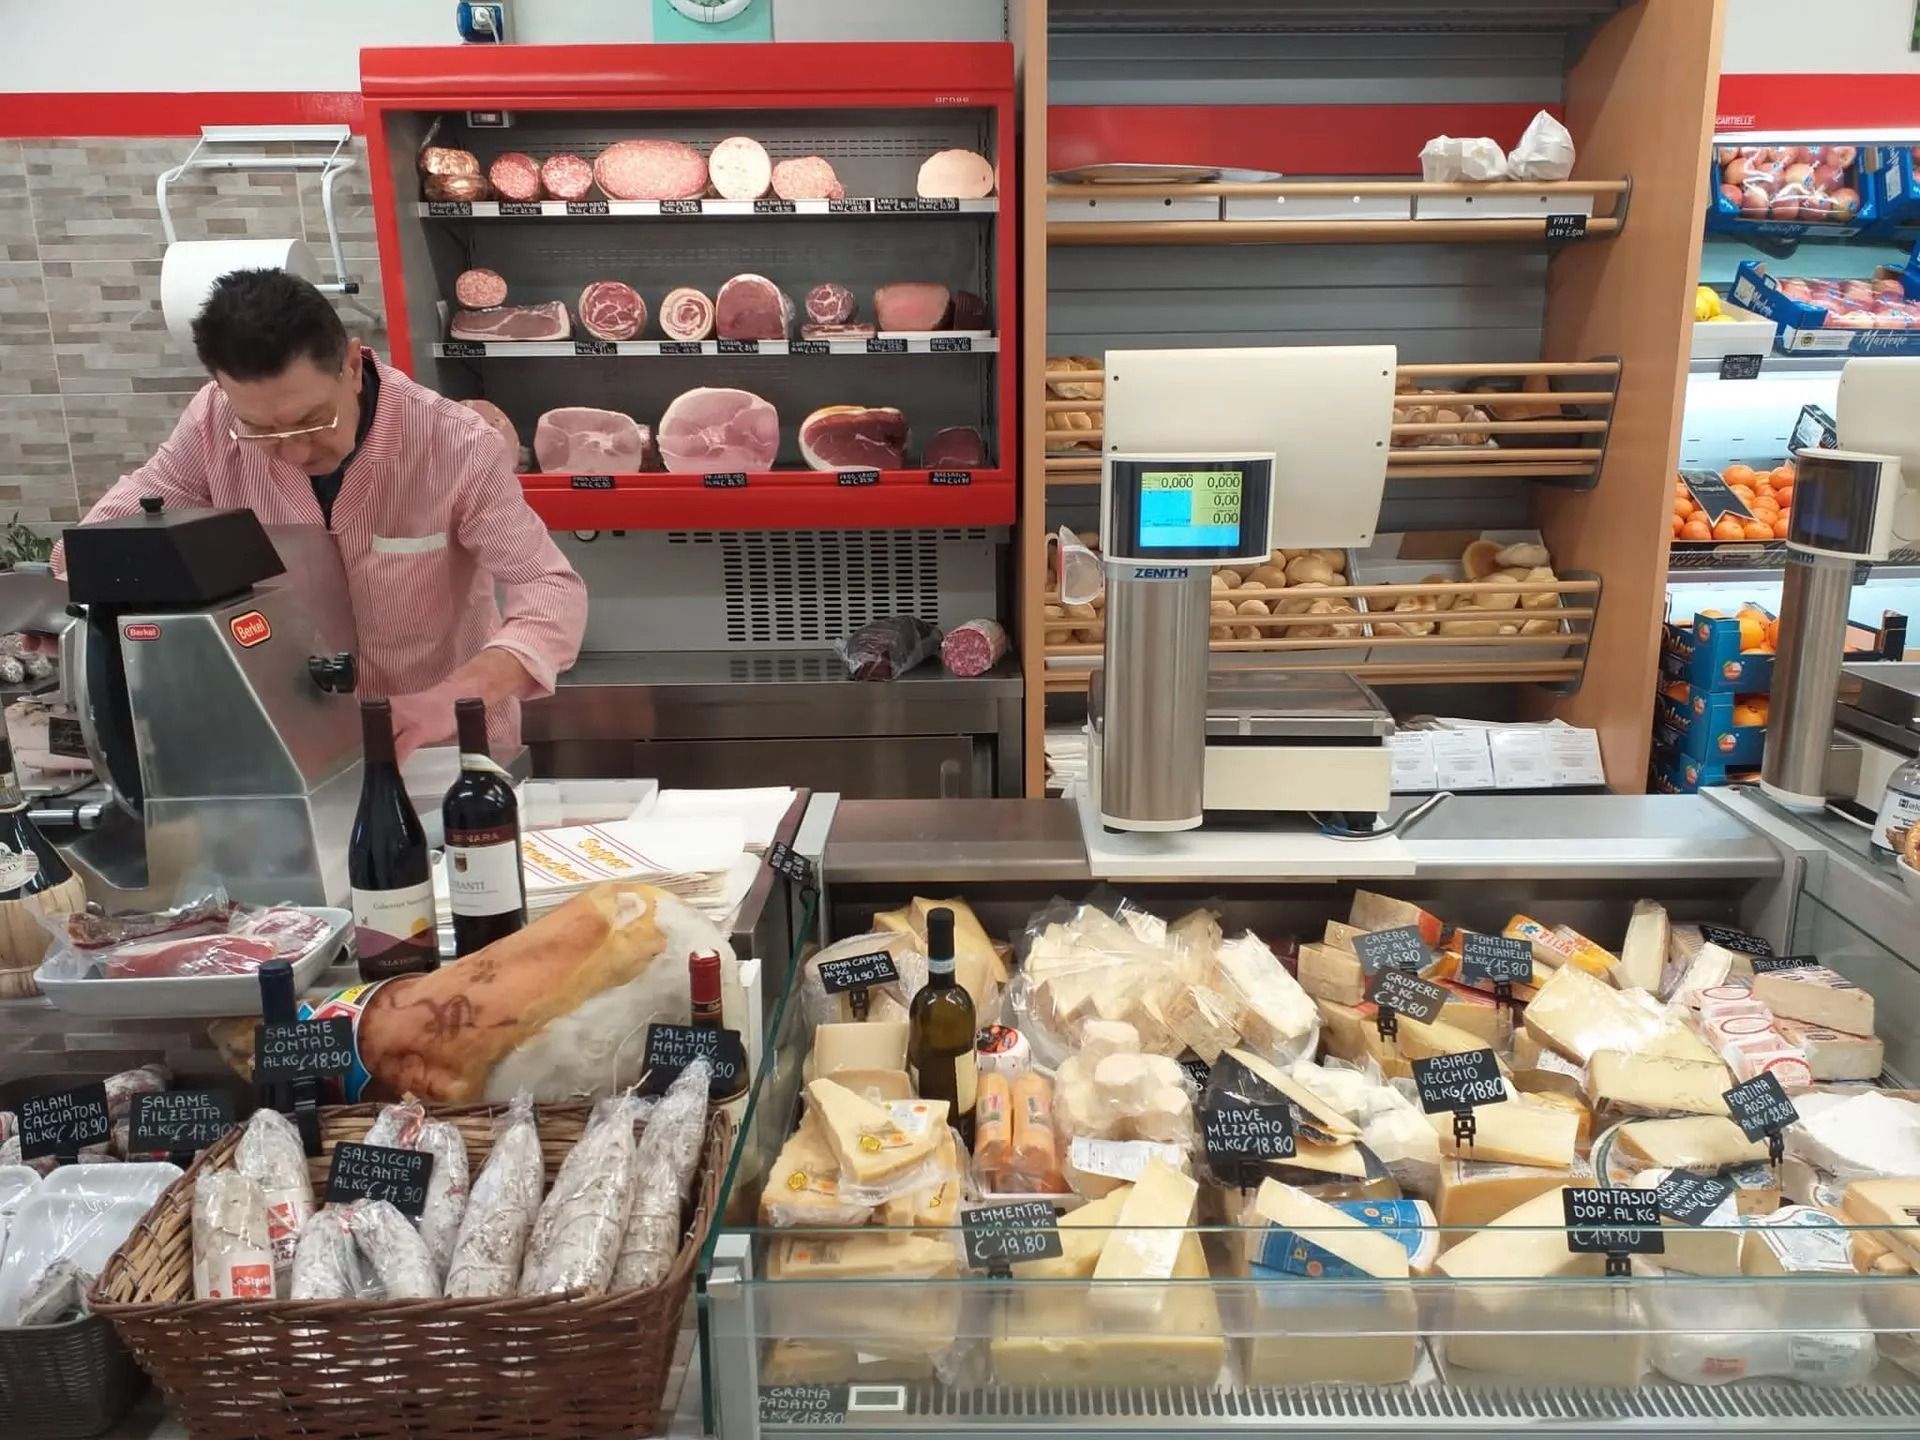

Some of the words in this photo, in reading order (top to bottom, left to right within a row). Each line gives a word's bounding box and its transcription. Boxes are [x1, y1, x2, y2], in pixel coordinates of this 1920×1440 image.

[1859, 331, 1908, 350] Marlene
[1161, 477, 1193, 489] 0,000
[1207, 476, 1240, 488] 0,000
[1214, 494, 1239, 506] 0,00
[1213, 512, 1238, 524] 0,00
[1134, 568, 1188, 579] ZENITH
[129, 627, 157, 637] Berkel
[235, 618, 266, 640] Berkel
[1365, 930, 1410, 945] CASERA
[1473, 934, 1522, 950] FONTINA
[821, 959, 851, 972] TOMA
[851, 953, 888, 968] CAPRA
[1754, 959, 1803, 971] TALEGGIO
[1385, 971, 1440, 1001] GRUYERE
[653, 1026, 719, 1044] SALAME
[1429, 1051, 1483, 1070] ASIAGO
[1419, 1066, 1478, 1086] VECCHIO
[141, 1094, 211, 1109] SALAME
[1727, 1079, 1771, 1107] FONTINA
[1743, 1093, 1776, 1115] AOSTA
[23, 1102, 103, 1131] CACCIATORI
[140, 1106, 221, 1124] FILZETTA
[1216, 1108, 1264, 1124] PIAVE
[1207, 1120, 1283, 1138] MEZZANO
[340, 1145, 423, 1169] SALSICCIA
[337, 1159, 411, 1182] PICCANTE
[1572, 1190, 1657, 1205] MONTASIO
[969, 1203, 1053, 1224] EMMENTAL
[770, 1387, 832, 1400] GRANA
[759, 1396, 828, 1410] PADANO
